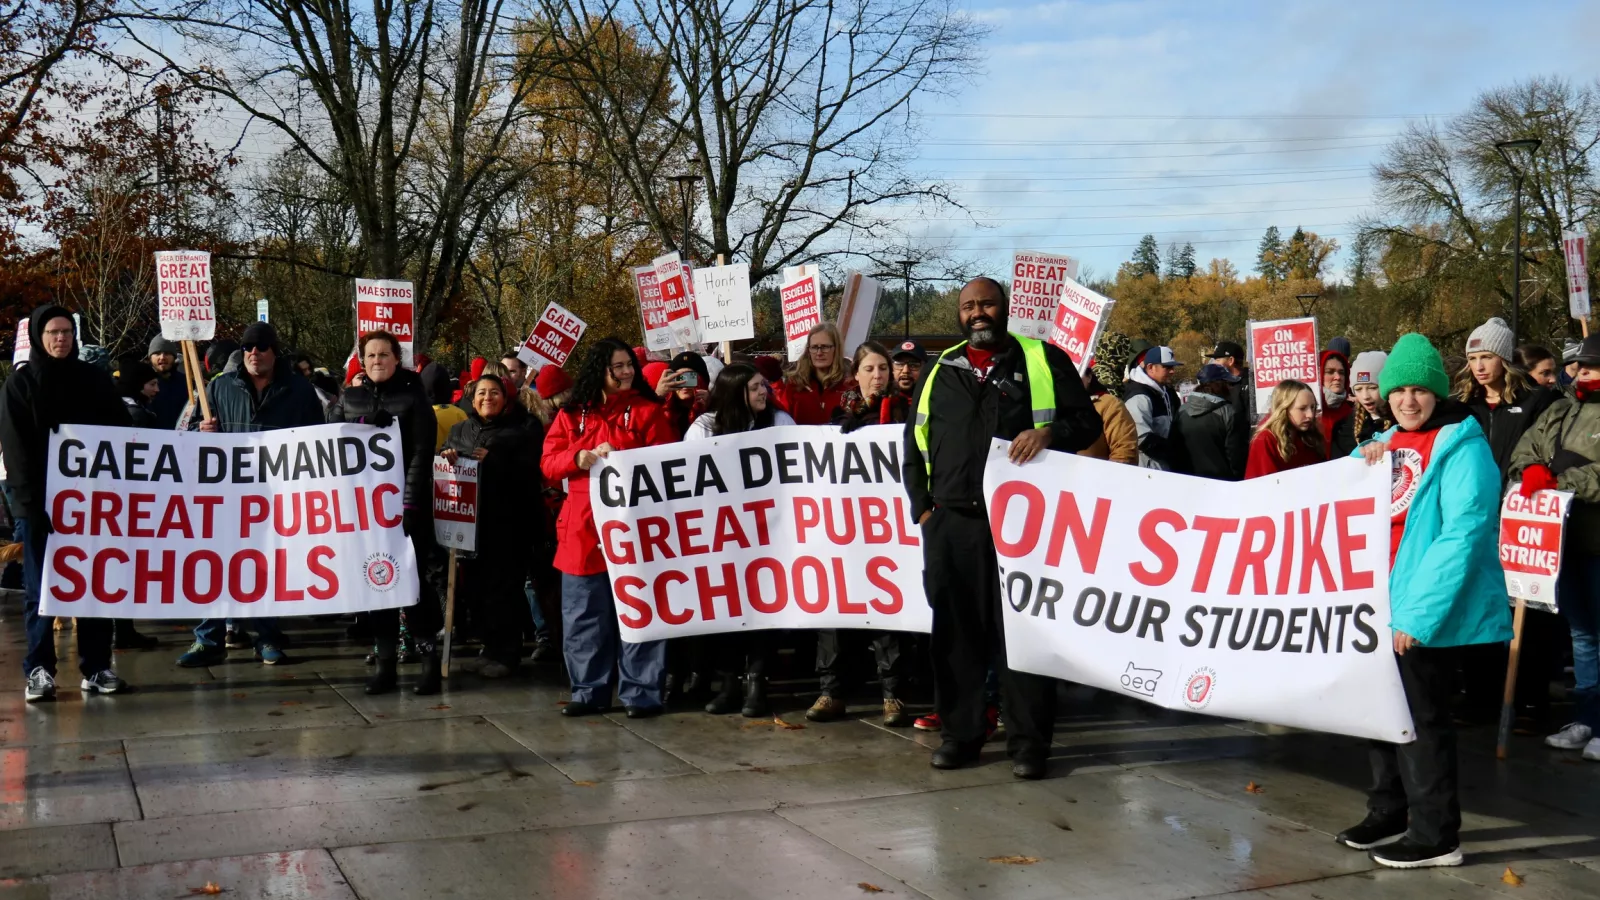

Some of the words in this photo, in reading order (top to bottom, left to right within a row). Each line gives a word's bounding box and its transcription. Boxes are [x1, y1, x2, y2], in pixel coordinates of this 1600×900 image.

[1016, 254, 1033, 262] GAEA
[1034, 256, 1068, 265] DEMANDS
[160, 263, 207, 278] GREAT
[1014, 263, 1067, 282] GREAT
[161, 280, 209, 294] PUBLIC
[667, 282, 676, 296] EN
[704, 272, 736, 290] Honk
[358, 286, 412, 298] MAESTROS
[783, 282, 813, 300] ESCUELAS
[162, 296, 212, 307] SCHOOLS
[717, 294, 732, 307] for
[786, 298, 809, 312] SEGURAS
[808, 295, 814, 304] Y
[1064, 285, 1102, 316] MAESTROS
[161, 309, 184, 320] FOR
[188, 309, 213, 320] ALL
[376, 306, 392, 318] EN
[700, 311, 748, 330] Teachers!
[784, 306, 817, 322] SALUDABLES
[1010, 306, 1034, 320] FOR
[1038, 310, 1054, 321] AL
[546, 308, 580, 338] GAEA
[790, 317, 816, 336] AHORA
[1062, 312, 1078, 332] EN
[546, 330, 562, 346] ON
[1274, 330, 1292, 342] ON
[530, 334, 566, 362] STRIKE
[1262, 341, 1307, 356] STRIKE
[1256, 356, 1280, 369] FOR
[1283, 354, 1314, 368] SAFE
[1258, 367, 1314, 382] SCHOOLS
[58, 438, 183, 484] GAEA
[198, 432, 396, 484] DEMANDS
[434, 463, 476, 477] MAESTROS
[600, 454, 728, 508] GAEA
[739, 441, 902, 490] DEMAN
[448, 484, 462, 498] EN
[52, 489, 224, 539] GREAT
[240, 482, 403, 538] PUBLIC
[435, 498, 474, 516] HUELGA
[1506, 490, 1560, 518] GAEA
[601, 498, 776, 564] GREAT
[793, 496, 920, 546] PUBL
[990, 480, 1112, 574] ON
[1128, 497, 1376, 596] STRIKE
[1518, 526, 1543, 546] ON
[1501, 544, 1558, 572] STRIKE
[50, 546, 340, 604] SCHOOLS
[614, 556, 904, 629] SCHOOLS
[1072, 586, 1170, 642] OUR
[1179, 603, 1378, 654] STUDENTS
[1120, 674, 1157, 692] oea
